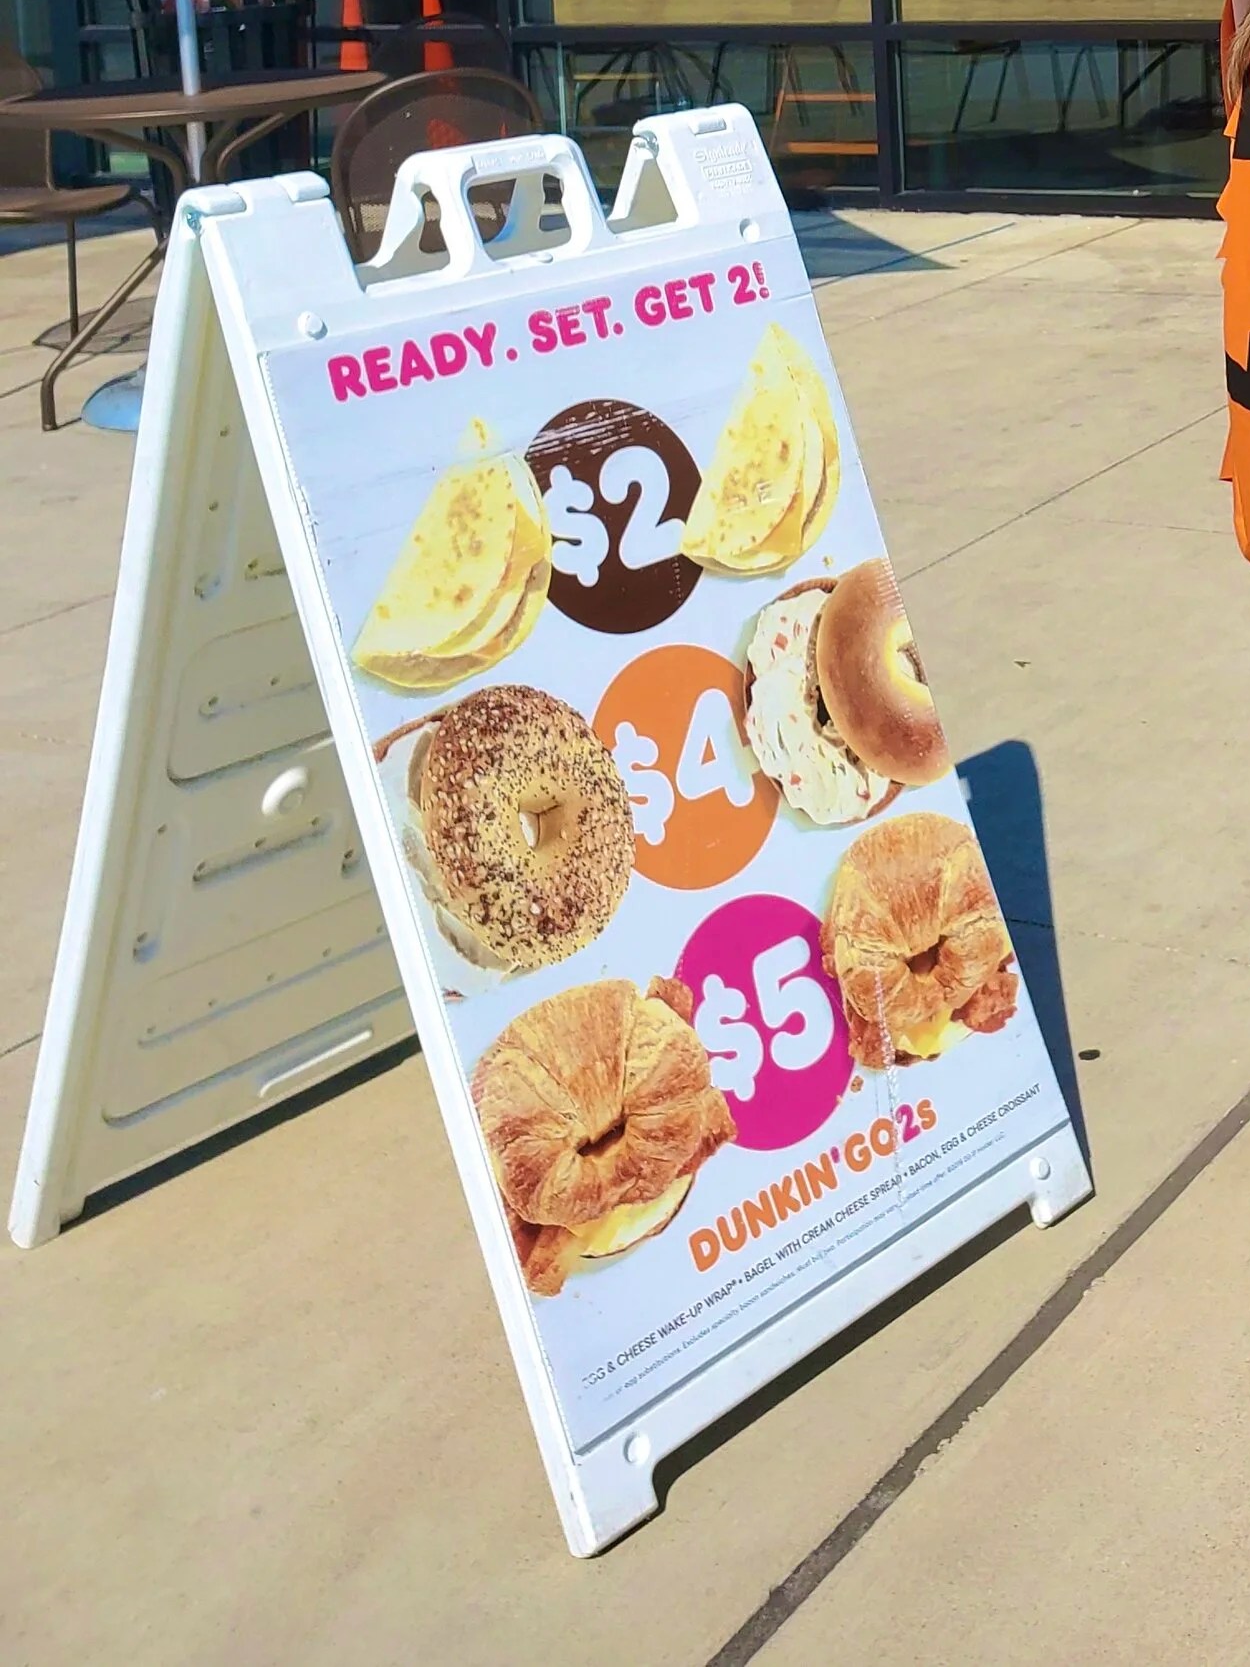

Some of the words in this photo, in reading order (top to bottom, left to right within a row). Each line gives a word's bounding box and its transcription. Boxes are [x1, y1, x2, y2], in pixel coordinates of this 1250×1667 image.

[327, 322, 518, 402] READY.
[528, 296, 624, 353] SET.
[634, 272, 716, 326] GET
[728, 261, 770, 305] 2!
[542, 446, 687, 588] $2
[612, 688, 761, 846] $4
[694, 936, 835, 1102] $5
[616, 1332, 657, 1365] CHEESE
[656, 1302, 702, 1338] WAKE-UP
[743, 1257, 775, 1282] BAGEL
[775, 1238, 801, 1260] WITH
[801, 1217, 834, 1244] CREAM
[834, 1194, 869, 1222] CHEESE
[908, 1149, 941, 1175] BACON,
[940, 1136, 959, 1154] EGG
[966, 1111, 997, 1136] CHEESE
